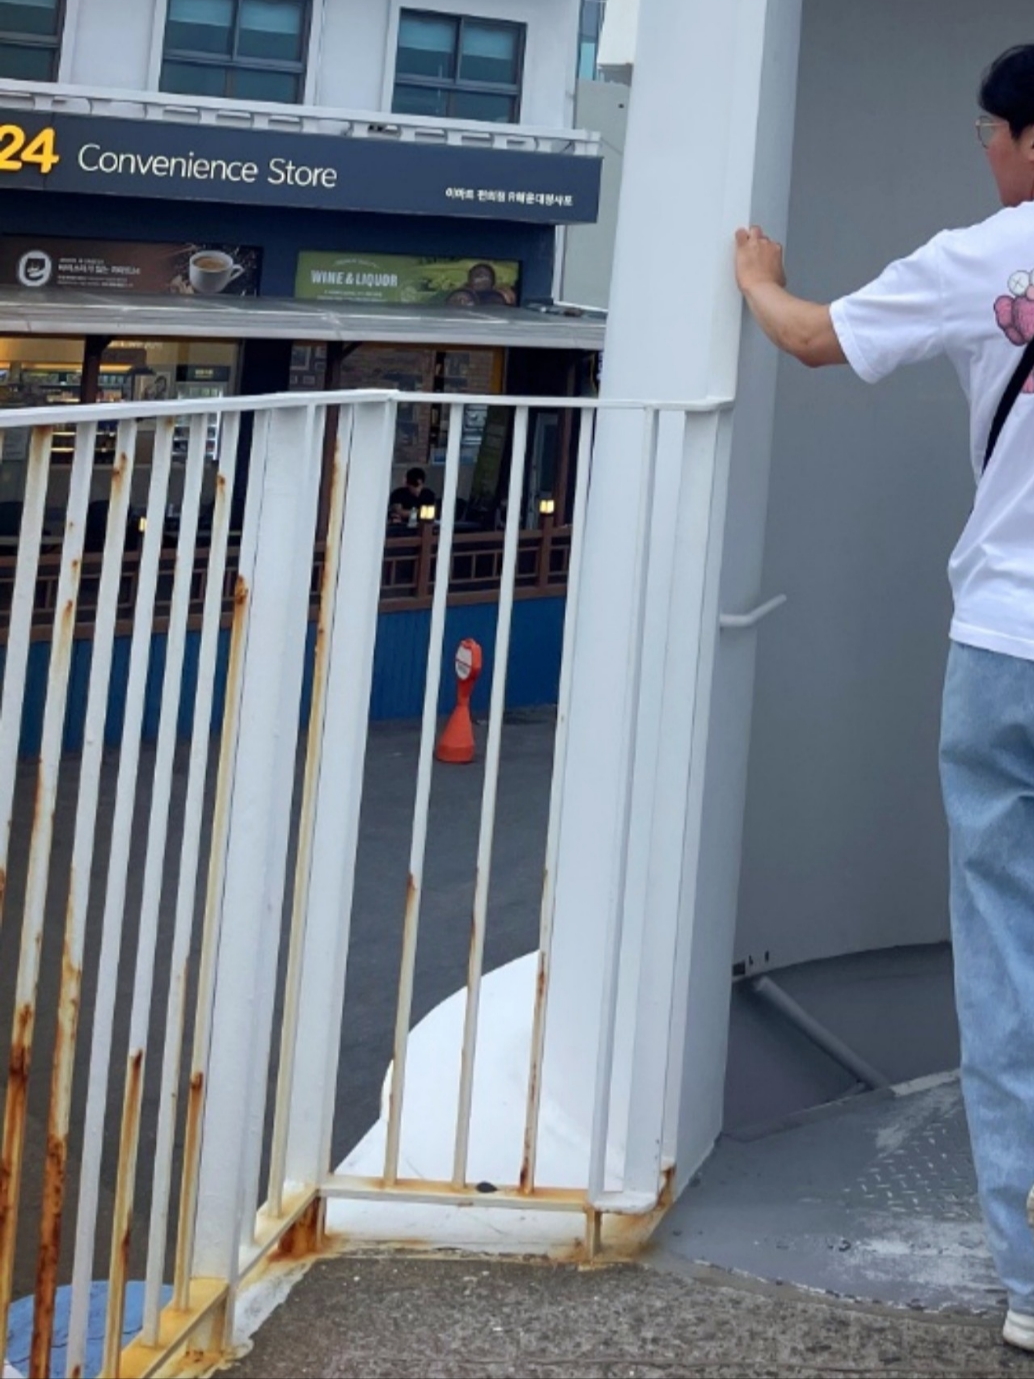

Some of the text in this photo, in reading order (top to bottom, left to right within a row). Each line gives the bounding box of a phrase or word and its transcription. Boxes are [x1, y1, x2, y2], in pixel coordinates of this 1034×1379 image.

[0, 124, 338, 188] 24 Convenience Store
[445, 187, 475, 200] 이마트
[311, 269, 398, 289] WINE & LIQUOR
